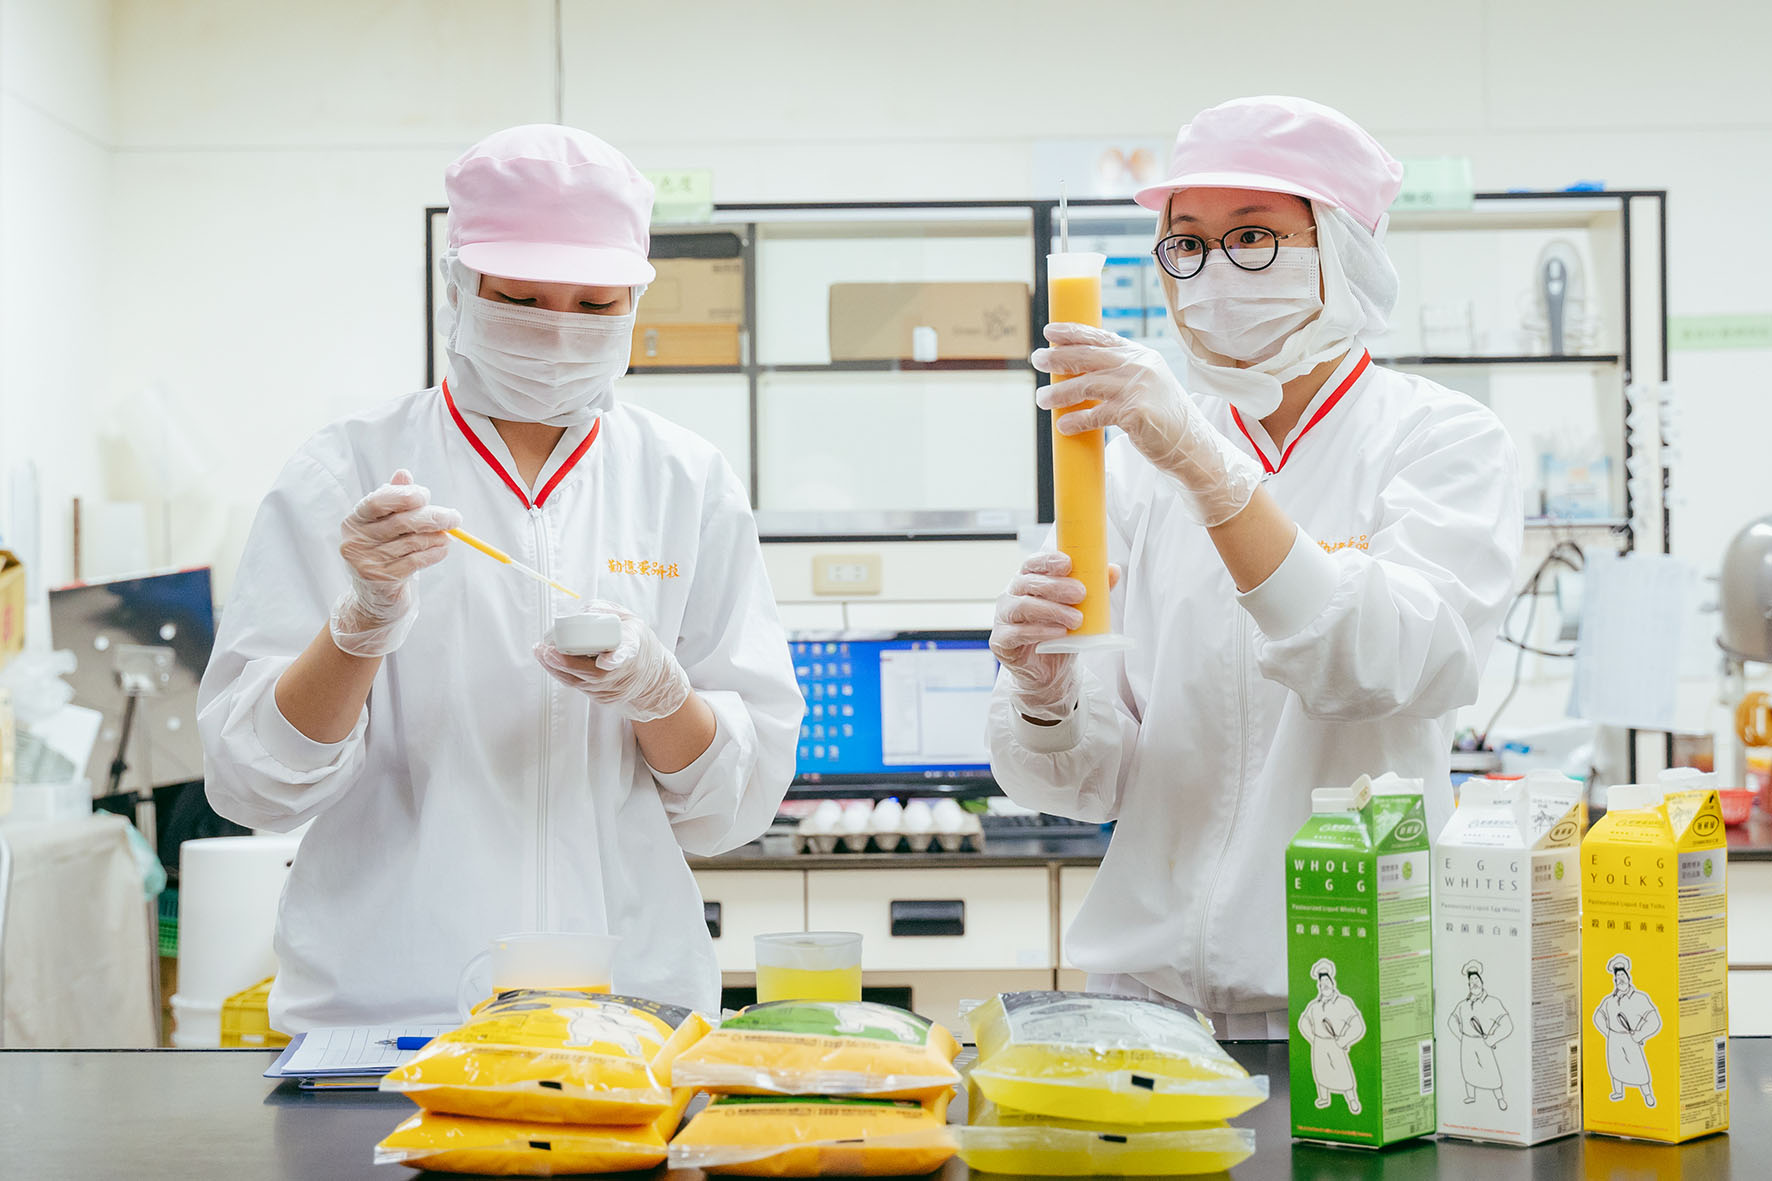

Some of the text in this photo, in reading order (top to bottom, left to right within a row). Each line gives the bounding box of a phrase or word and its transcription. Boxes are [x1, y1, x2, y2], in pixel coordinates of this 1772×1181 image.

[1294, 859, 1365, 874] WHOLE
[1445, 858, 1519, 873] EGG
[1591, 854, 1664, 869] EGG
[1294, 878, 1365, 892] EGG
[1445, 877, 1518, 891] WHITES
[1590, 873, 1664, 887] YOLKS
[1357, 907, 1368, 915] Egg
